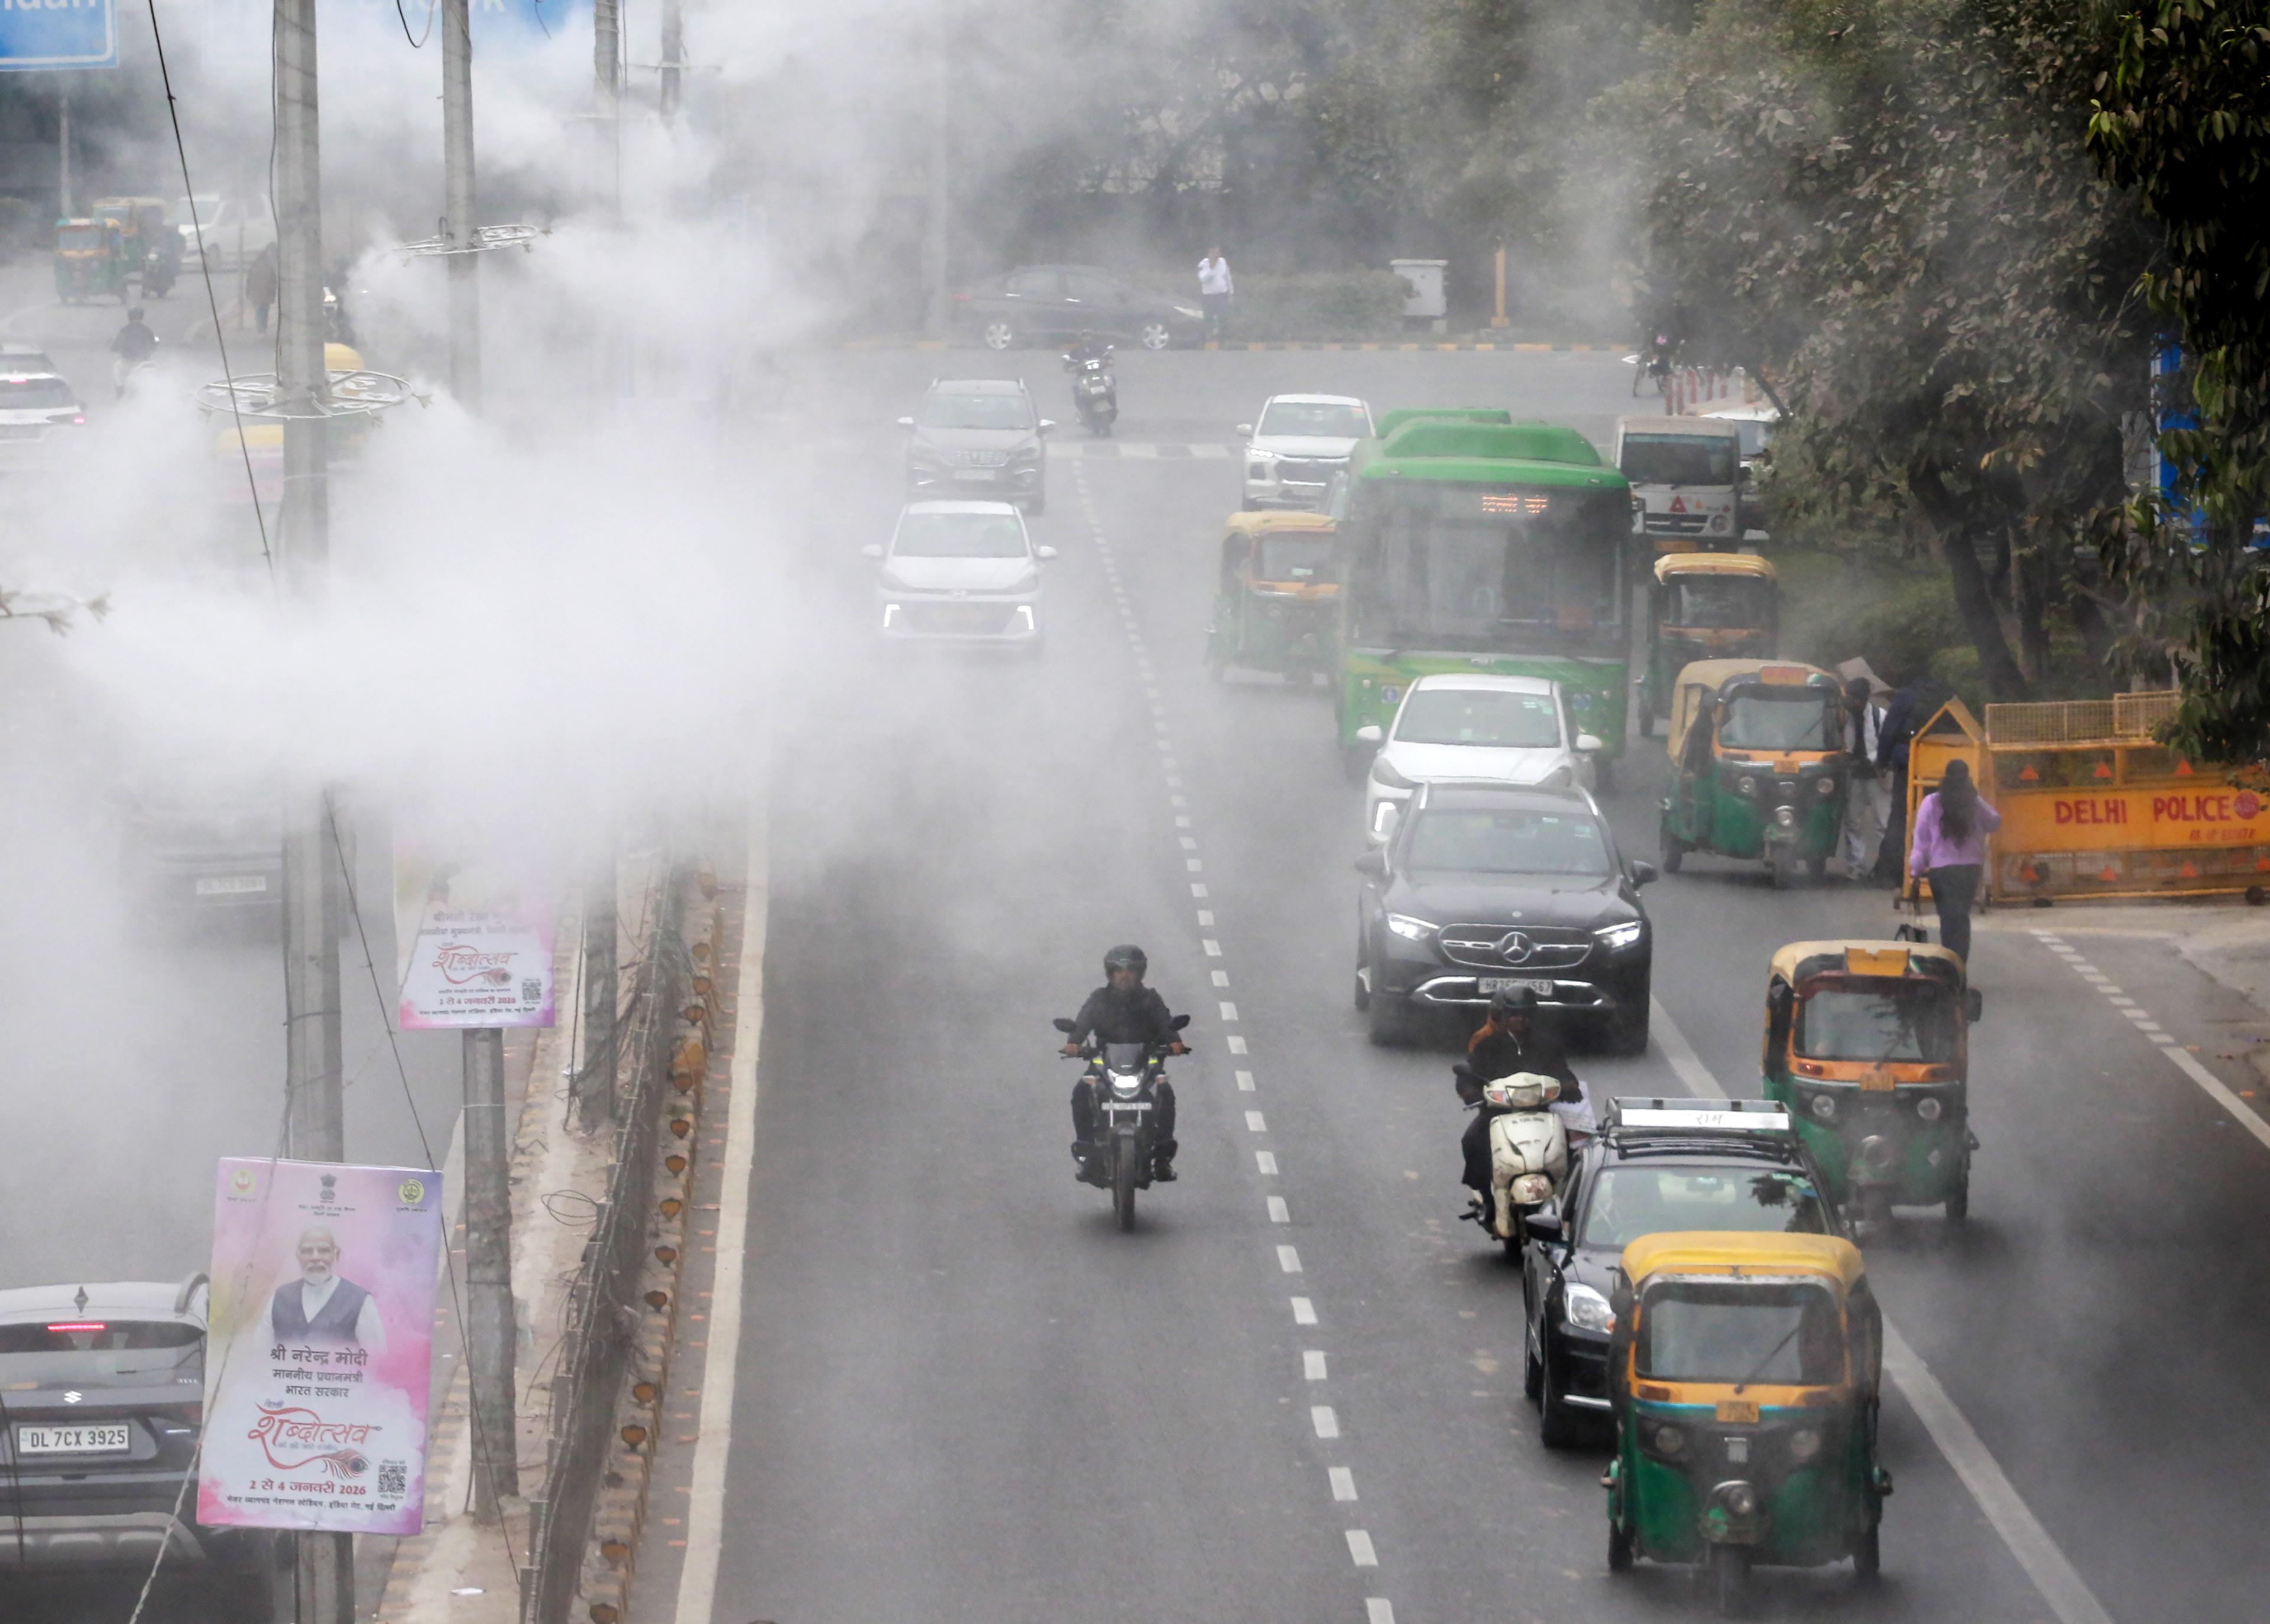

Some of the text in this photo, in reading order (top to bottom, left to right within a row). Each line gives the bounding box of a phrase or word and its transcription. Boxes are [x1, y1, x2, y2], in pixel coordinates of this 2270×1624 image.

[2054, 795, 2232, 824] DELHI POLICE
[270, 1344, 368, 1366] श्री नरेन्द्र मोदी
[273, 1368, 363, 1383] माननीय प्रधानमंत्री
[286, 1385, 349, 1397] भारत सरकार
[31, 1430, 125, 1447] DL 7CX 3925
[247, 1415, 374, 1446] शब्दोत्सव
[250, 1478, 366, 1495] 2 से 4 जनवरी 2026
